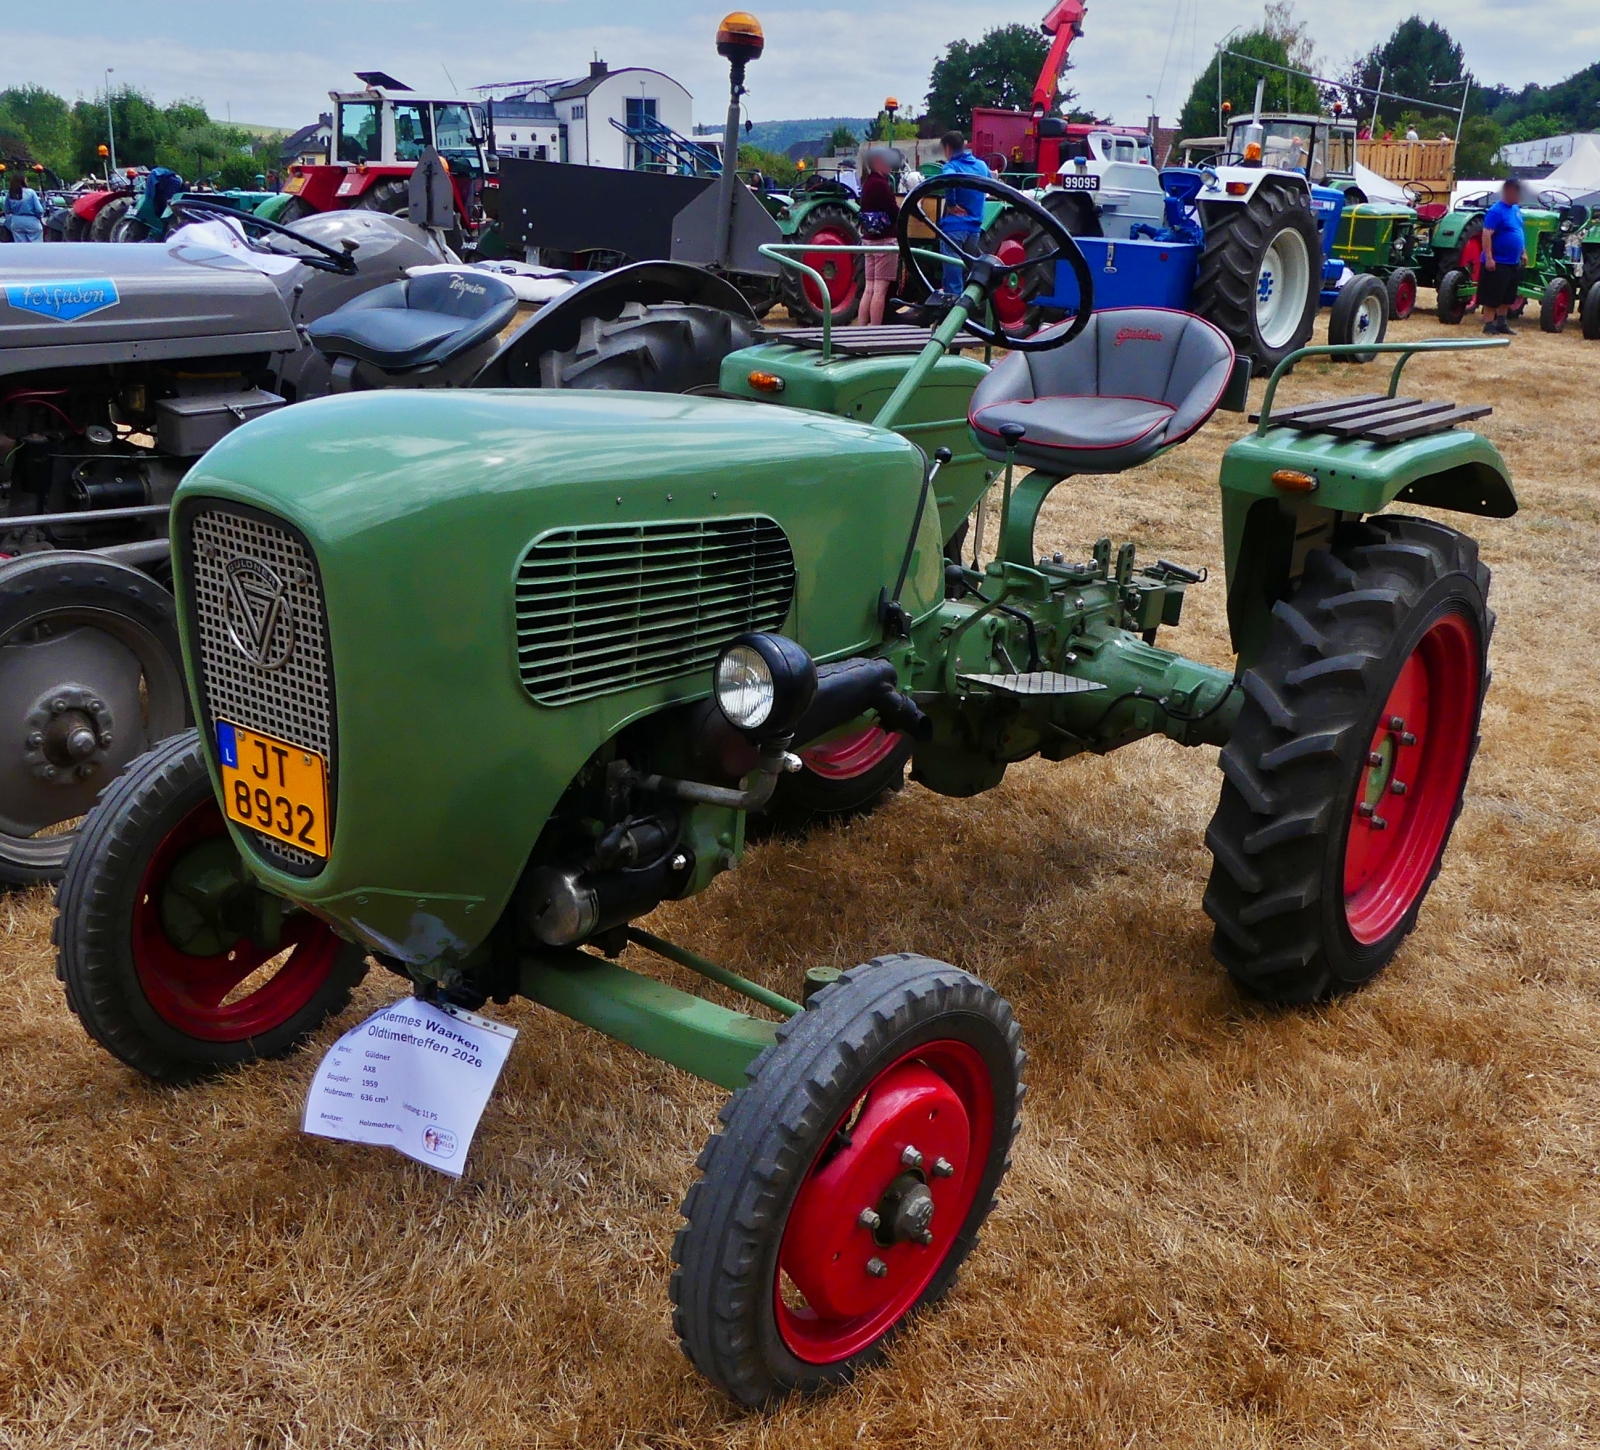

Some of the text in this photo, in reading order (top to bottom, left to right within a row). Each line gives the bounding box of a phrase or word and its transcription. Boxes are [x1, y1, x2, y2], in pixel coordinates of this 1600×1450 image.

[1065, 177, 1097, 189] 99095
[22, 286, 105, 315] Ferguson
[225, 748, 233, 762] L
[252, 739, 289, 788] JT
[234, 779, 316, 848] 8932
[425, 1019, 479, 1052] Waarken
[368, 1025, 482, 1068] Oldtimertreffen 2026
[365, 1050, 391, 1061] Güldner
[363, 1064, 377, 1074] AX8
[361, 1079, 379, 1089] 1959
[323, 1086, 355, 1098] Hubraum:
[360, 1093, 373, 1102] 636
[422, 1109, 429, 1118] 11
[430, 1112, 438, 1121] PS
